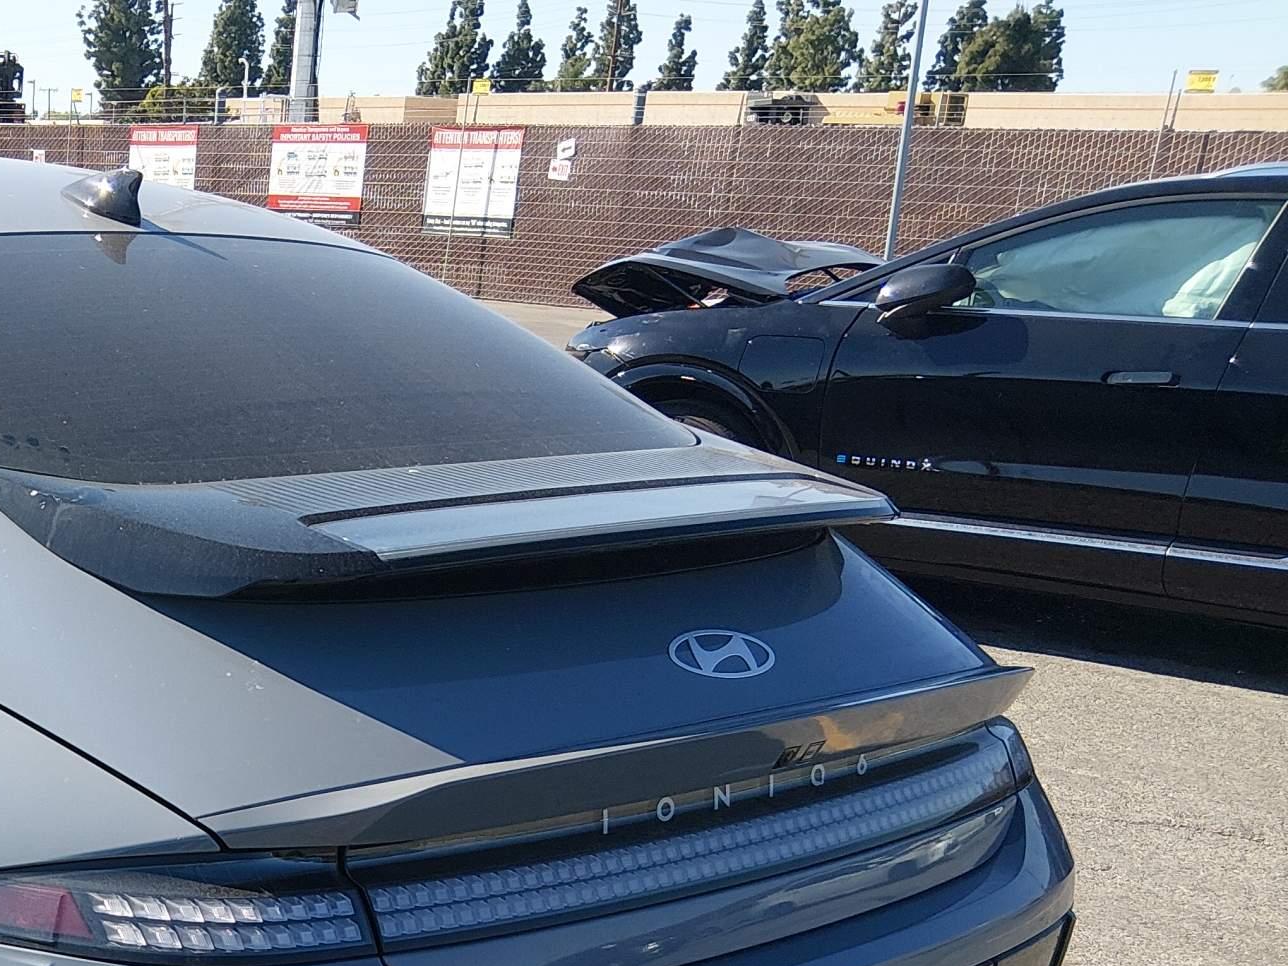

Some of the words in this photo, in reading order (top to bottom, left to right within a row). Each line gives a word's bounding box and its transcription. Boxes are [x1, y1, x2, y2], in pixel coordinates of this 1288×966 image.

[333, 133, 361, 141] POLICIES
[602, 763, 825, 835] IONIQ
[857, 753, 868, 775] 6
